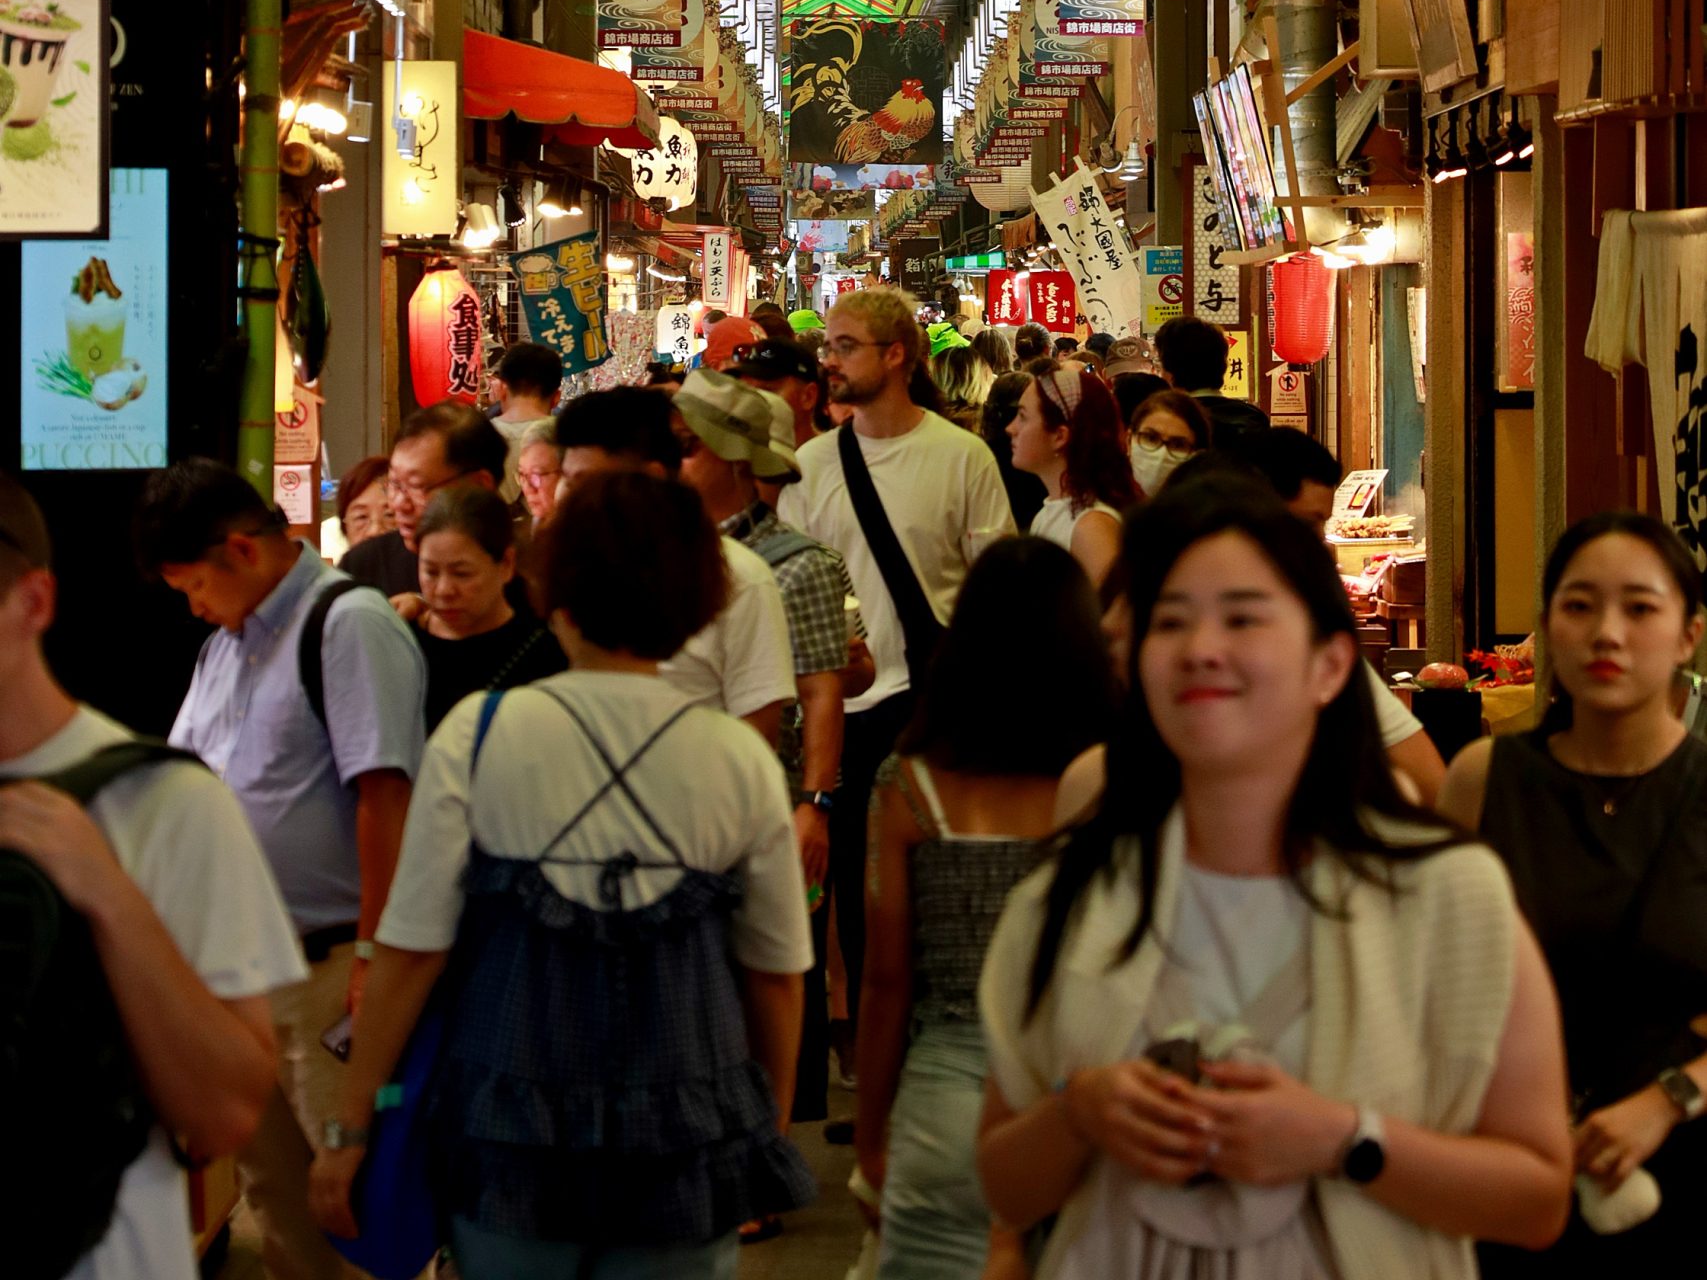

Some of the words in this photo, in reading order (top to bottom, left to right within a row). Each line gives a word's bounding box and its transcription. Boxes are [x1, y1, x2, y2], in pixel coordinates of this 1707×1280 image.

[1066, 22, 1136, 34] 錦市場商店街
[604, 33, 674, 45] 錦市場商店街
[637, 69, 697, 79] 錦市場商店街
[1041, 65, 1102, 74] 錦市場商店街
[557, 239, 610, 362] 生ビール
[450, 293, 480, 395] 食事処
